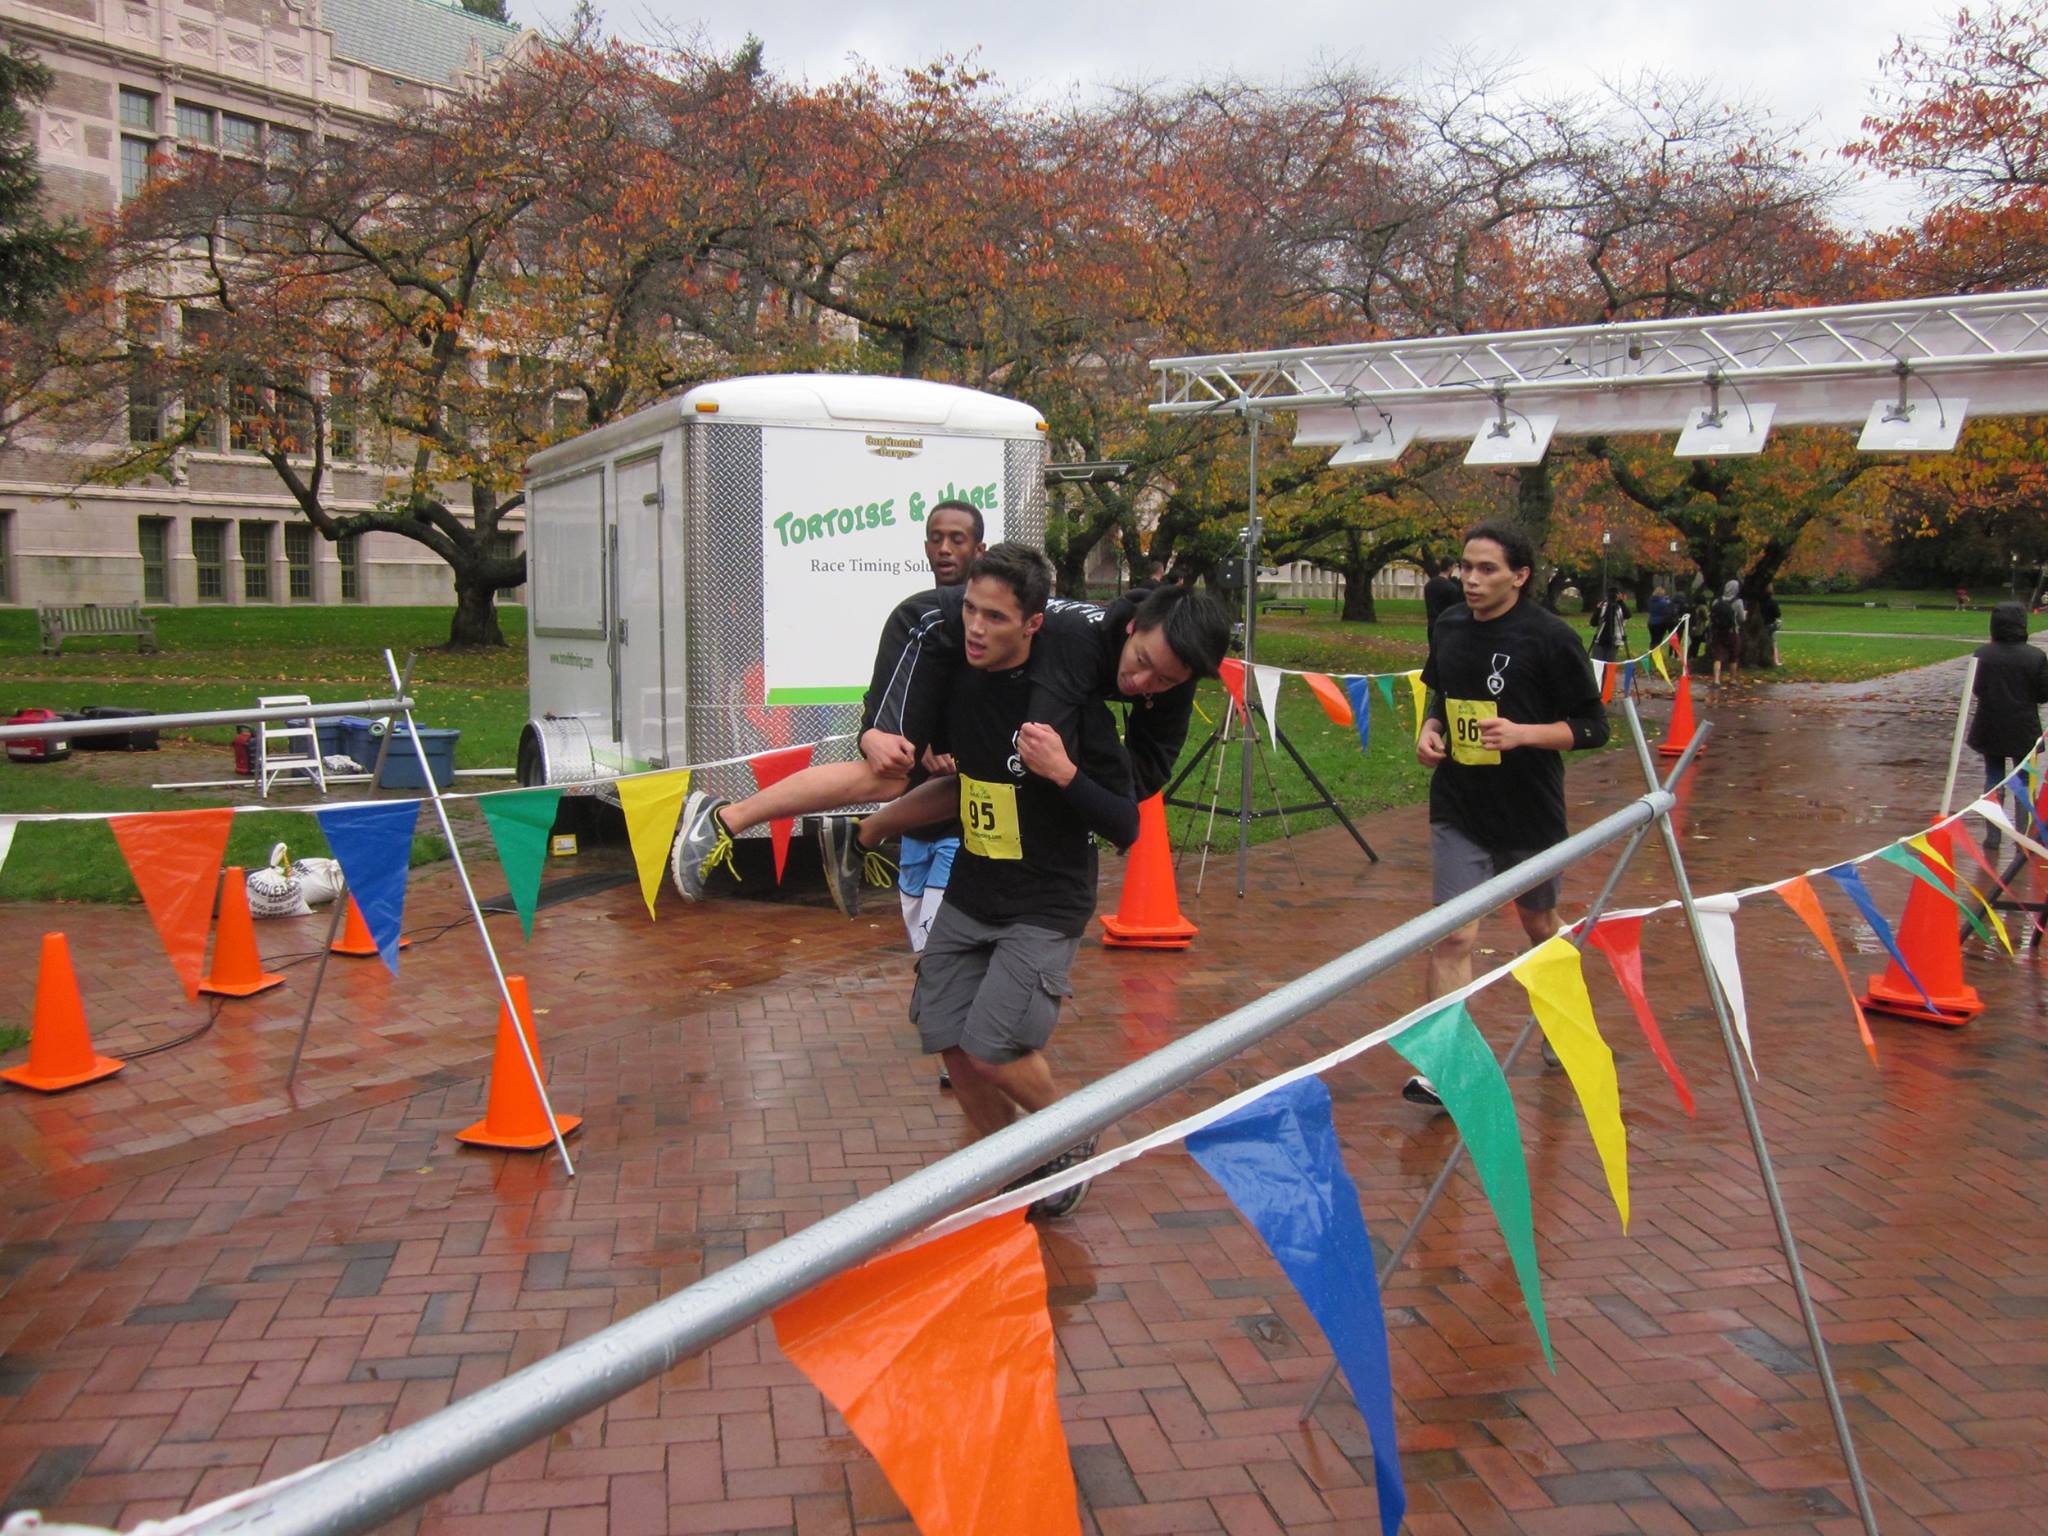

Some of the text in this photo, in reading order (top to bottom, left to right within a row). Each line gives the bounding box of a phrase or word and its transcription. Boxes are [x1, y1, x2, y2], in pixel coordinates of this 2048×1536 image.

[773, 498, 896, 547] TORTOISE
[908, 491, 926, 522] &
[811, 558, 845, 573] Race
[849, 558, 901, 576] Timing
[1457, 716, 1479, 742] 96
[969, 799, 996, 831] 95
